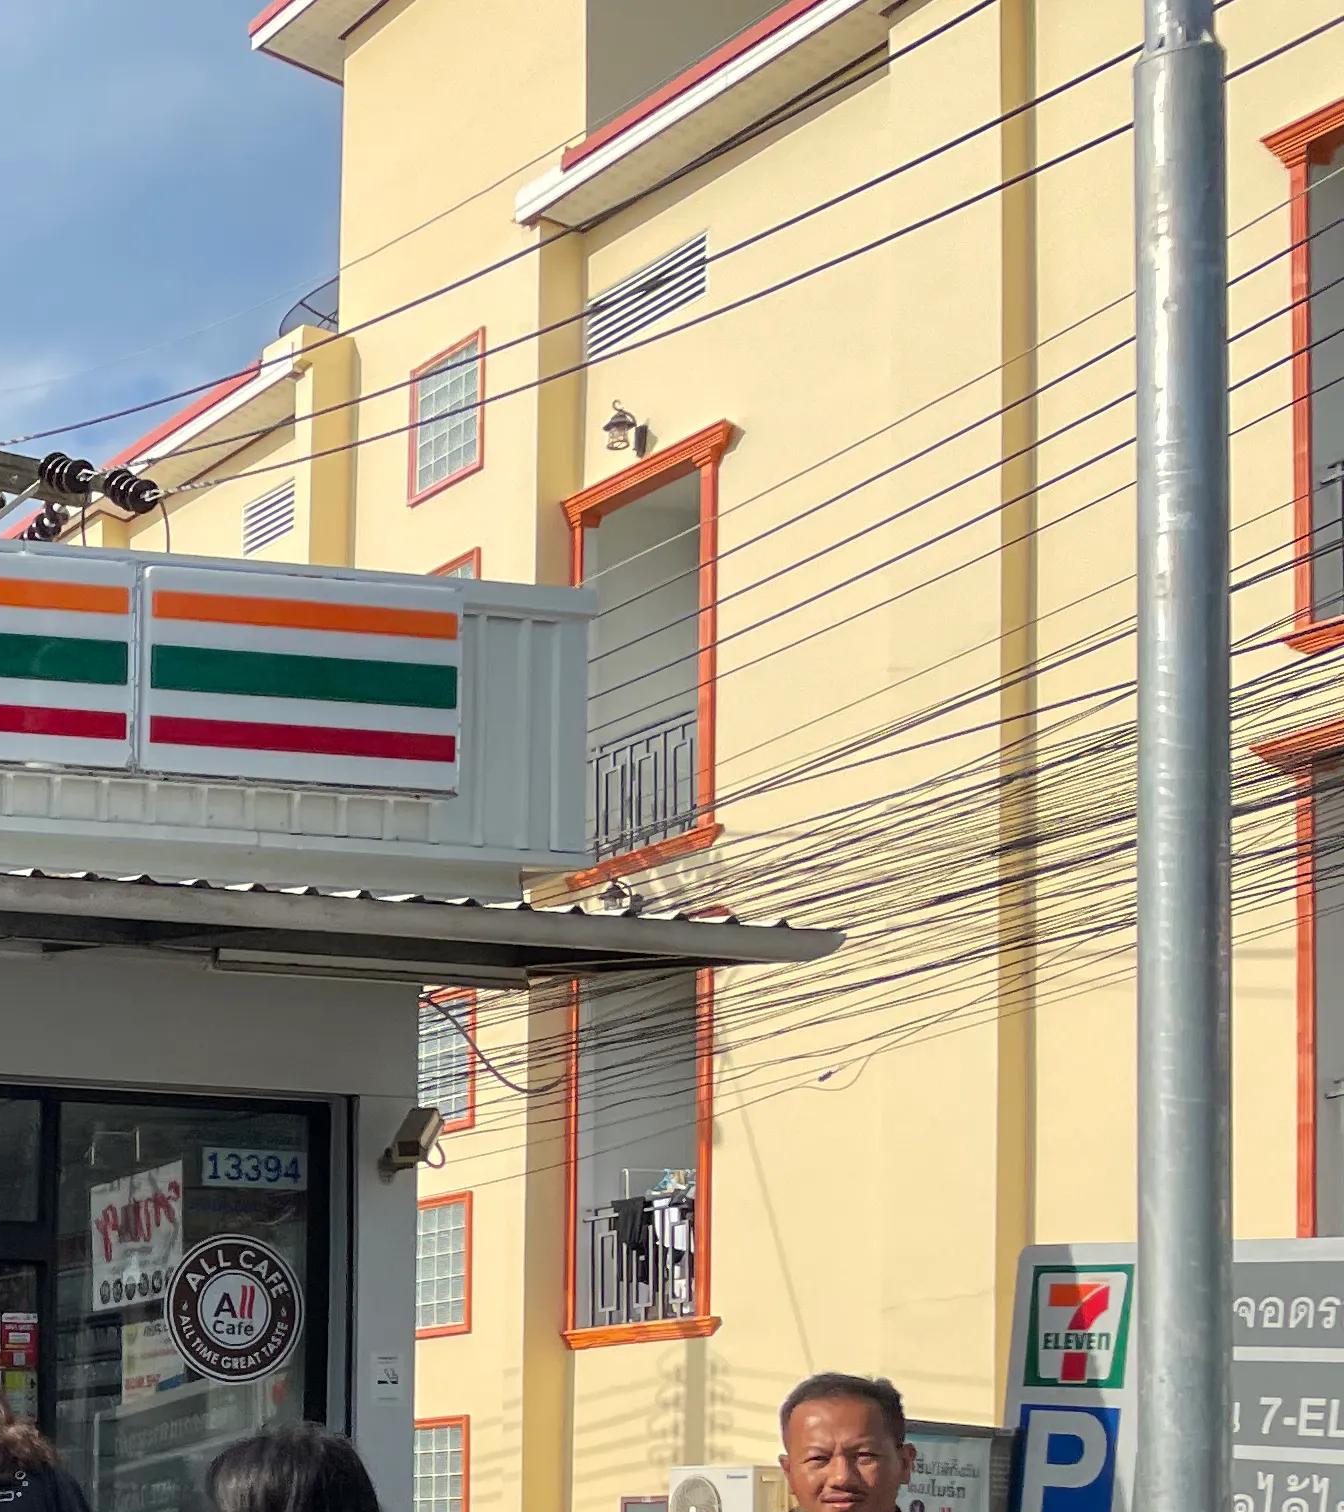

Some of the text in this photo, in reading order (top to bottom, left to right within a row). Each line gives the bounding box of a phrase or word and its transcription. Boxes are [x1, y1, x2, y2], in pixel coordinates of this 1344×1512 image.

[208, 1152, 302, 1183] 13394
[186, 1250, 232, 1292] ALL
[179, 1314, 196, 1340] ALL
[191, 1337, 220, 1366] TIME
